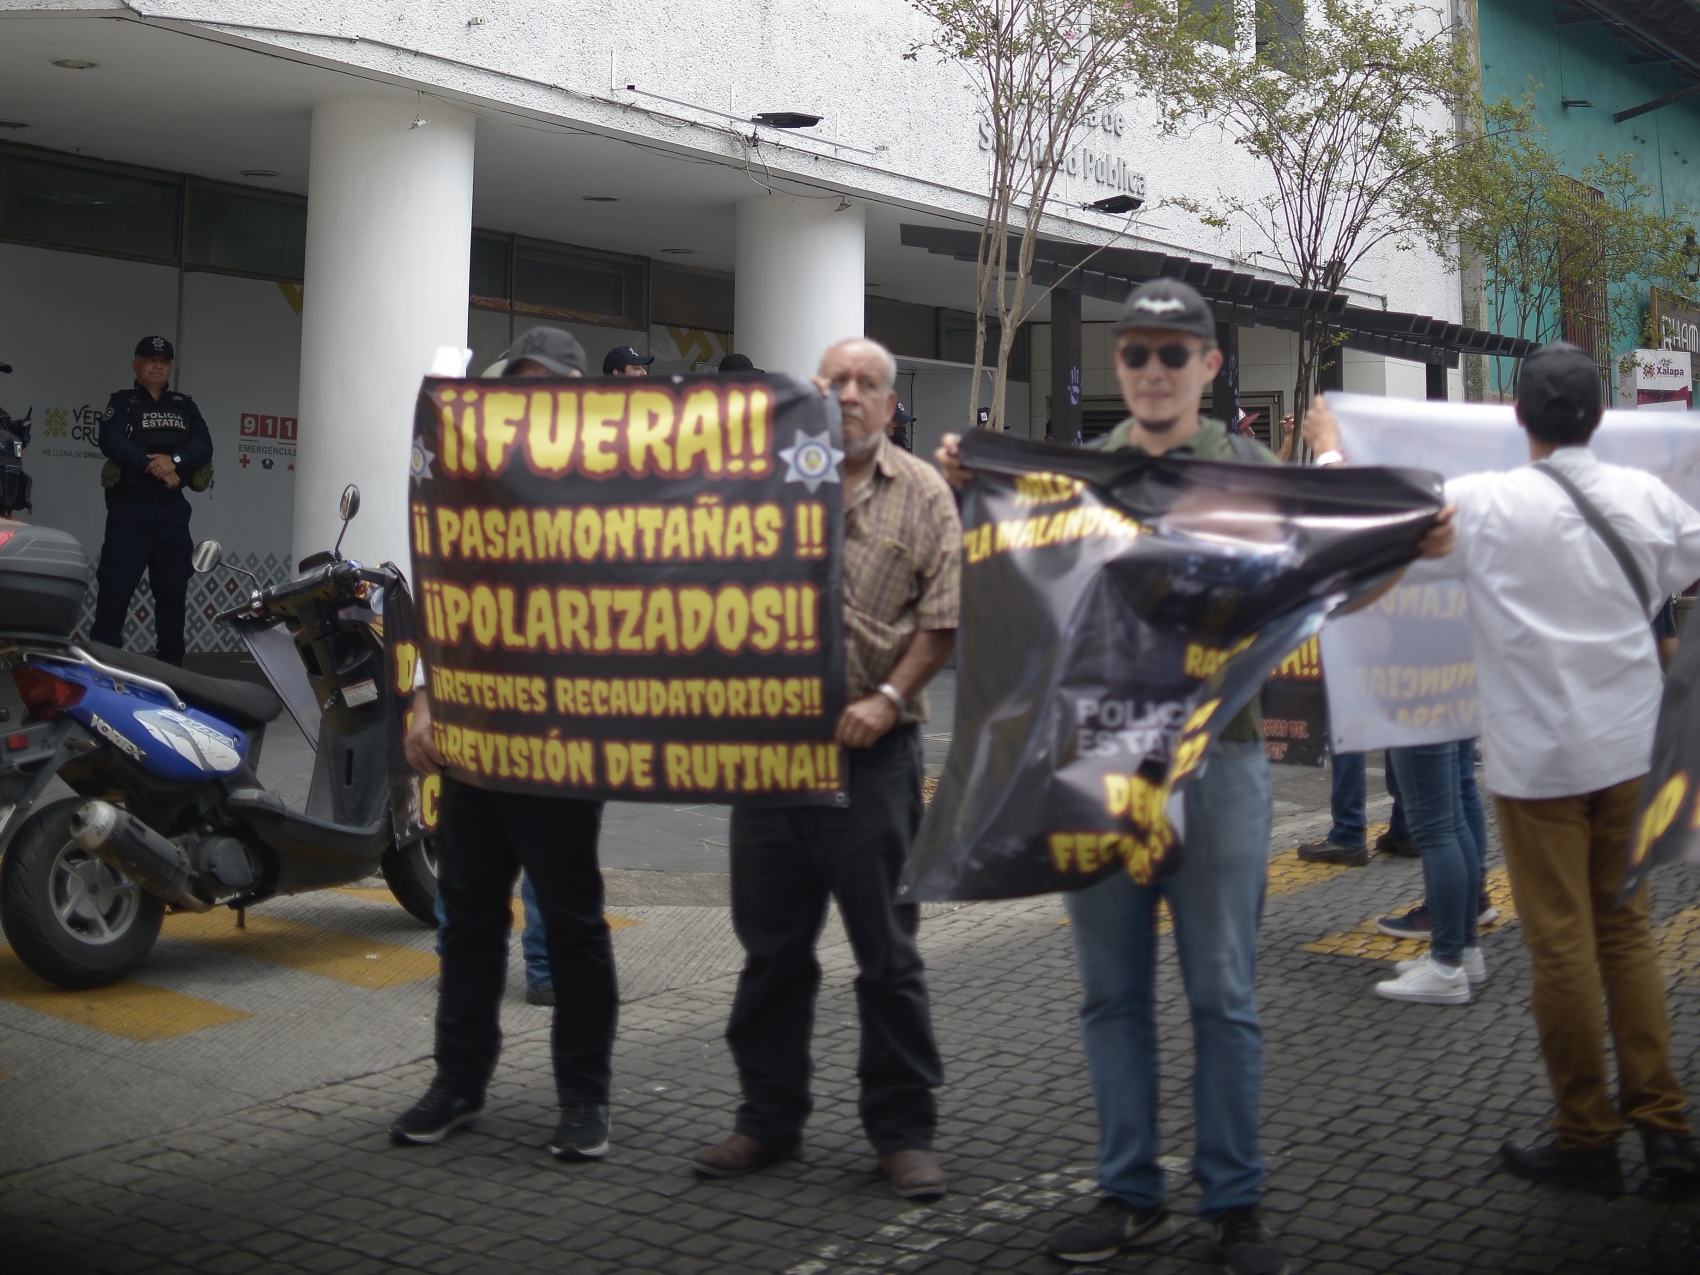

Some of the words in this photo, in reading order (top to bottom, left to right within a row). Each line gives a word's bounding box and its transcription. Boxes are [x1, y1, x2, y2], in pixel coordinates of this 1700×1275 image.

[1083, 146, 1147, 196] Pública
[1656, 366, 1685, 378] Xalapa
[141, 419, 187, 429] ESTATAL
[242, 415, 294, 438] 911
[42, 448, 52, 456] ME
[53, 450, 73, 458] LLENA
[74, 451, 83, 459] DE
[436, 496, 783, 561] PASAMONTAÑAS
[423, 581, 819, 653] ¡¡POLARIZADOS!!
[555, 677, 823, 717] RECAUDATORIOS!!
[90, 712, 147, 762] VORTEX
[605, 742, 654, 788] DE
[665, 742, 841, 792] RUTINA!!
